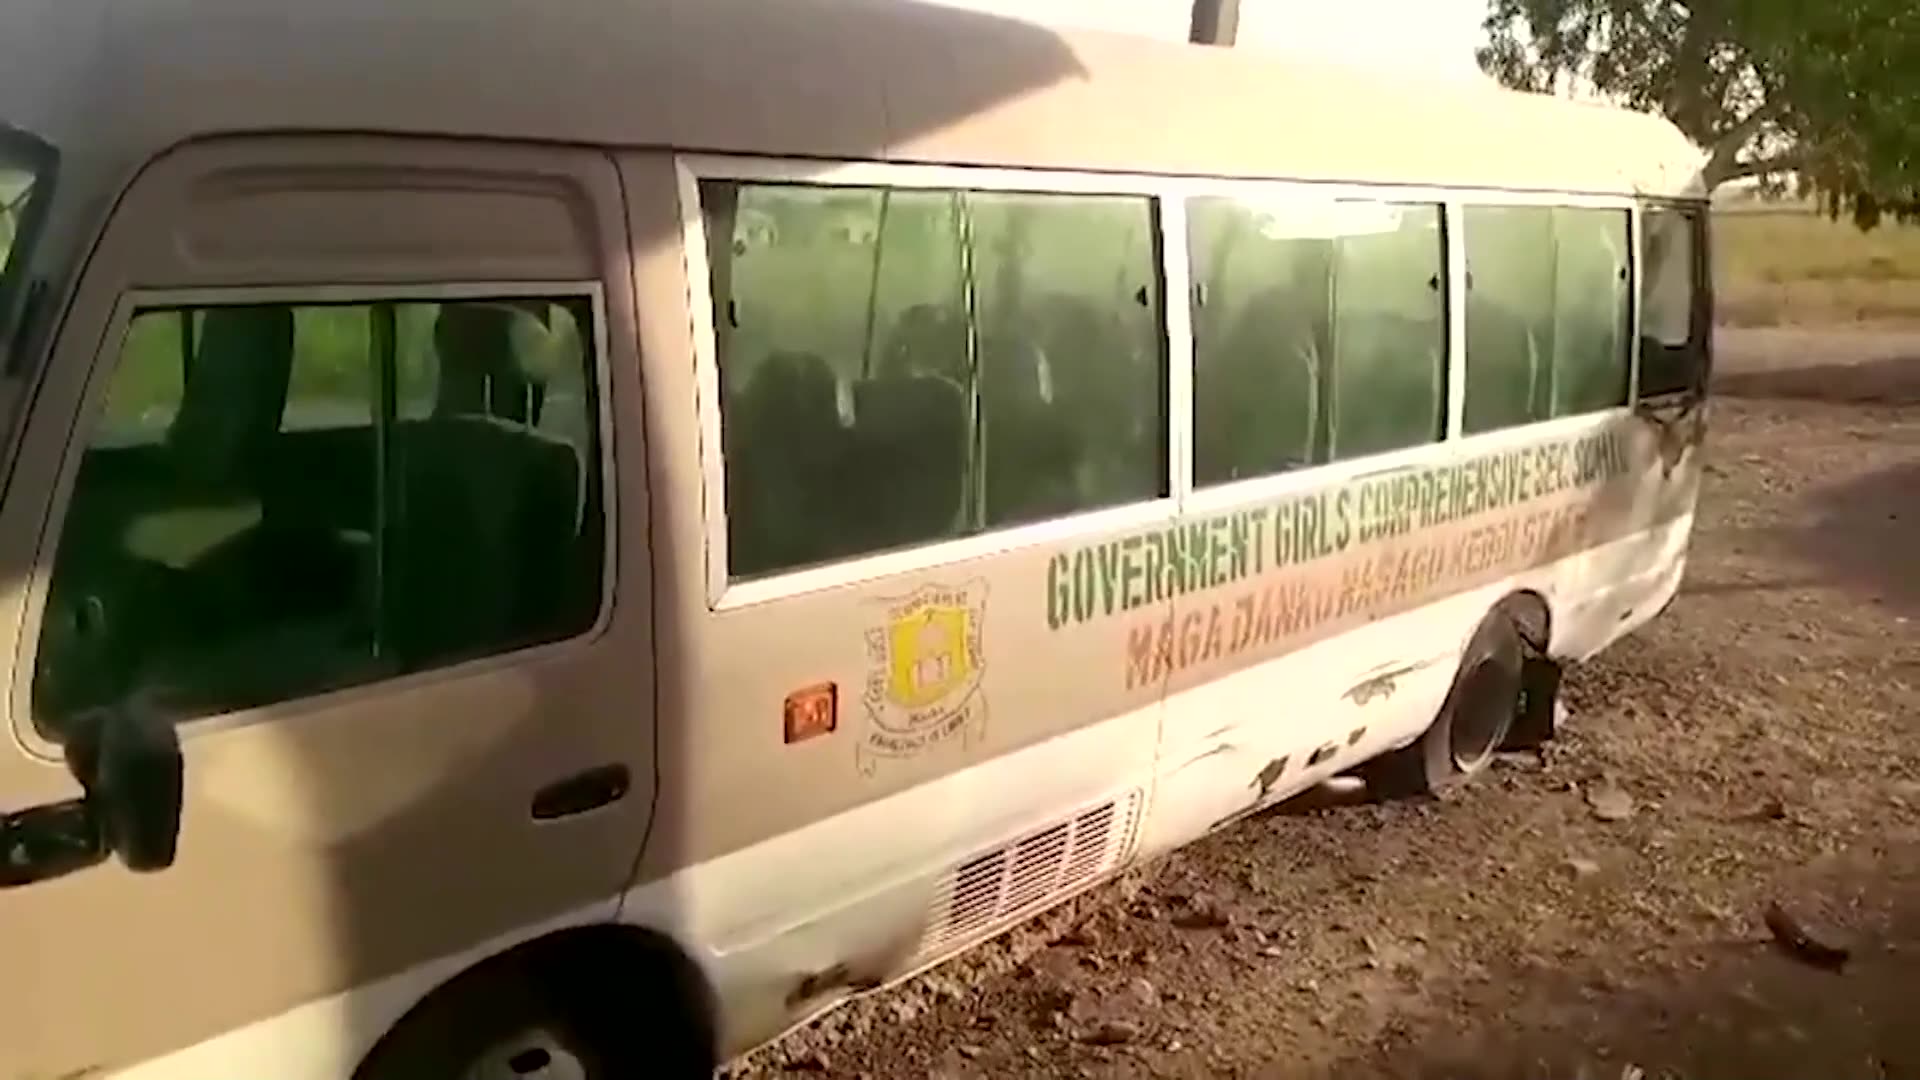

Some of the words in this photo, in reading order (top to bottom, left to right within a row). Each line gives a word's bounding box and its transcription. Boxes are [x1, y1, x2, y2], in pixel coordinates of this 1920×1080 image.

[1046, 506, 1268, 631] GOVERNMENT
[1274, 487, 1350, 568] GIRLS
[1358, 447, 1533, 543] COMPREHENSIVE
[1123, 604, 1222, 692] MAGA
